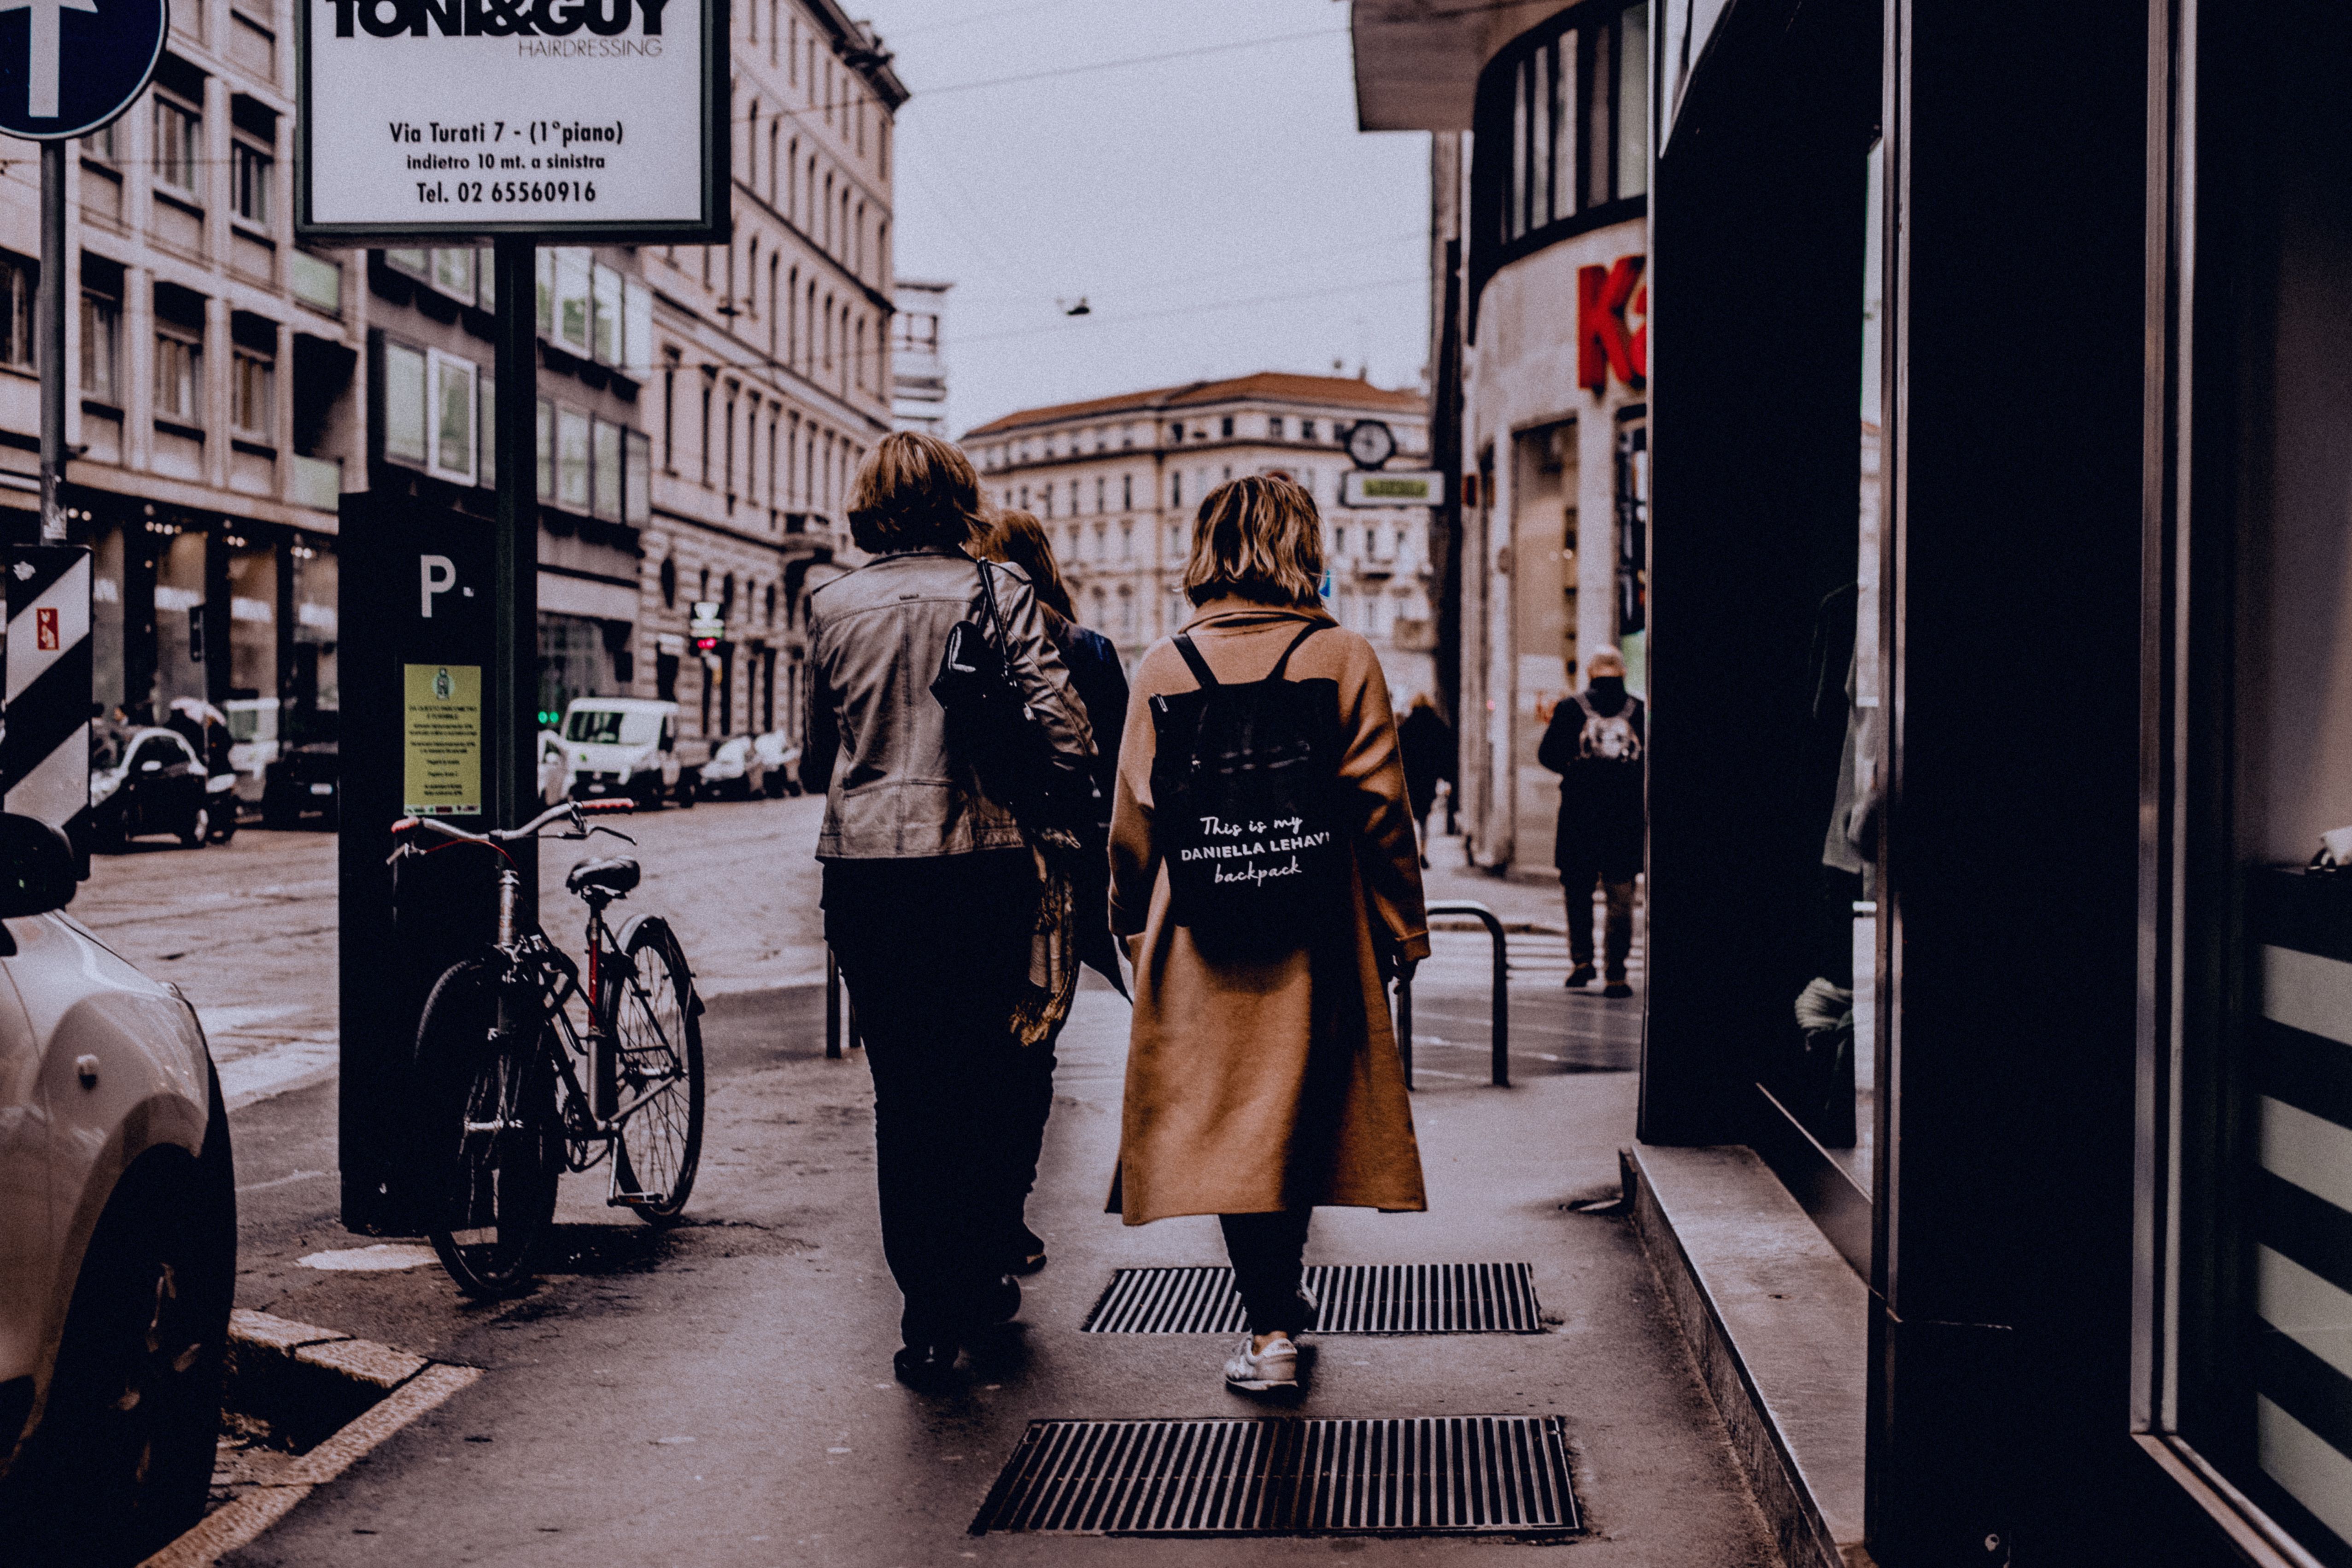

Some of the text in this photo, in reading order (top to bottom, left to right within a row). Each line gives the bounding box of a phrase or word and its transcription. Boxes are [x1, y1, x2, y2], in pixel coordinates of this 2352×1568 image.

[325, 0, 669, 37] TONI&GUY
[518, 39, 663, 58] HAIRDRESSING
[390, 123, 421, 143] Via
[429, 122, 485, 143] Turati
[494, 122, 505, 142] 7
[407, 153, 605, 169] indietro 10 mt. a sinistra
[416, 181, 596, 203] Tel. 02 65560916
[421, 555, 456, 618] P
[1200, 816, 1303, 837] This is my
[1181, 842, 1265, 861] DANIELLA
[1215, 855, 1302, 887] backpack
